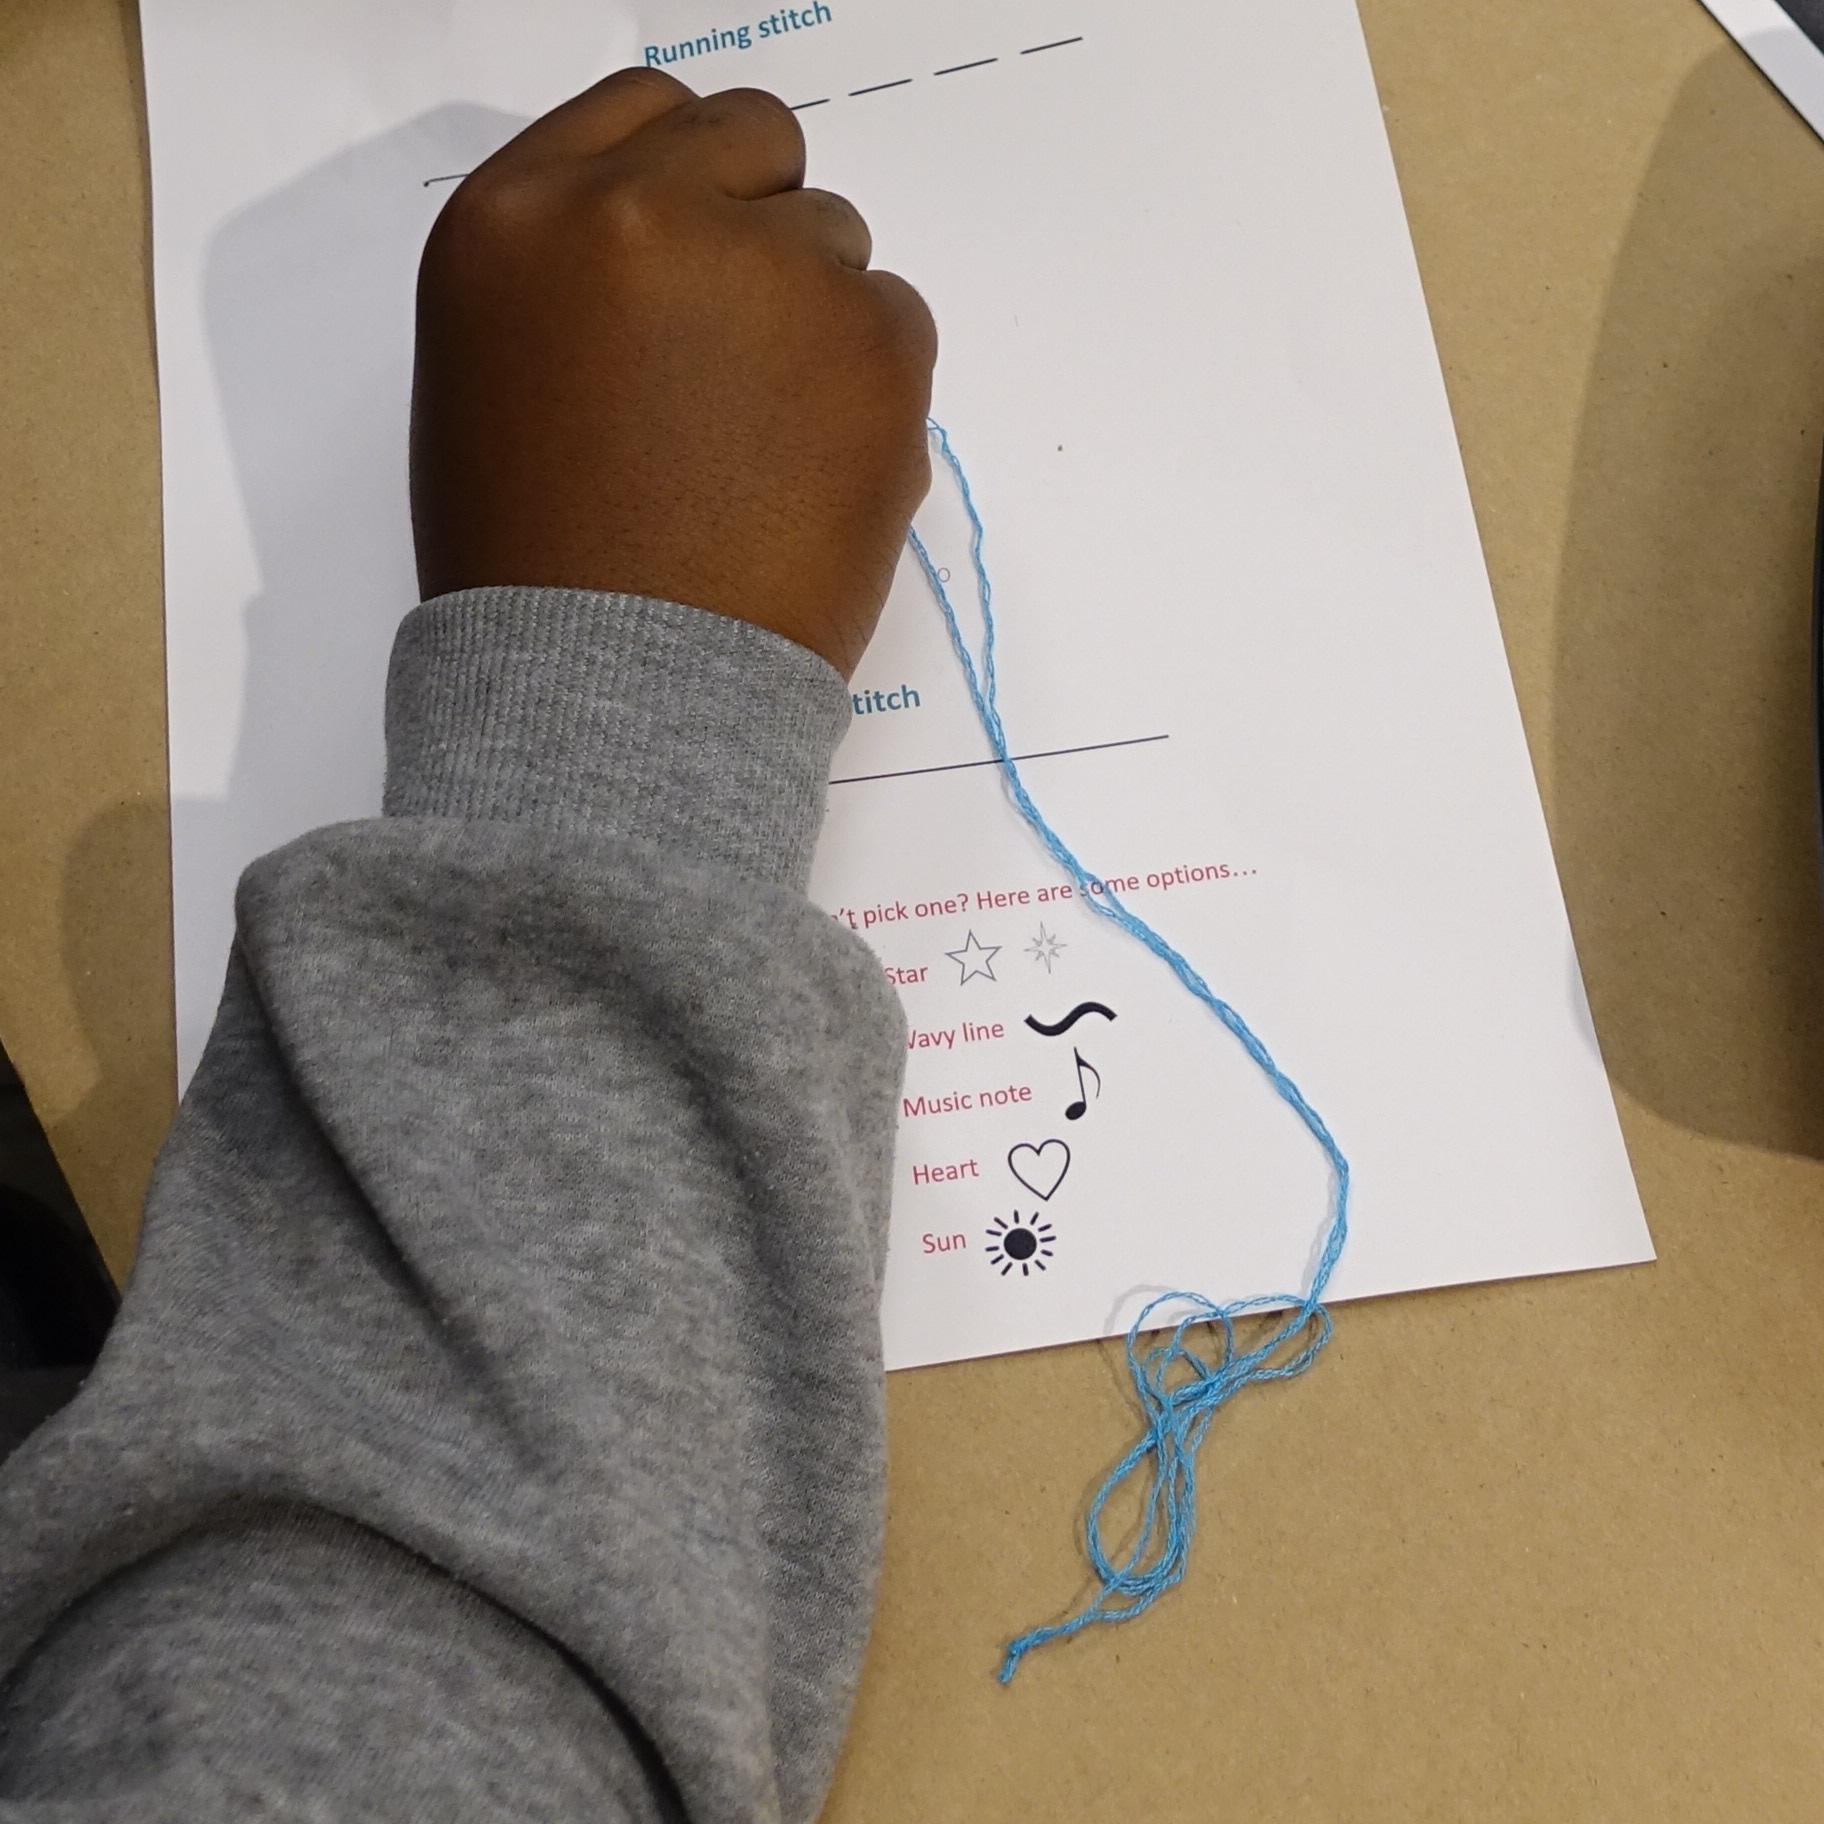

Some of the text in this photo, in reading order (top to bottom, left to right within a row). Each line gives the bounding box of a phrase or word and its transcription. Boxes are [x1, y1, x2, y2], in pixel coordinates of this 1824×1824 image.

[644, 0, 833, 67] Running stitch
[851, 684, 921, 715] titch
[863, 901, 909, 928] pick
[914, 893, 969, 918] one?
[977, 890, 1030, 910] Here
[1037, 884, 1073, 902] are
[884, 966, 928, 985] Star
[962, 1022, 1005, 1042] line
[902, 1085, 1032, 1117] Music note
[912, 1159, 980, 1185] Heart
[922, 1233, 967, 1254] Sun
